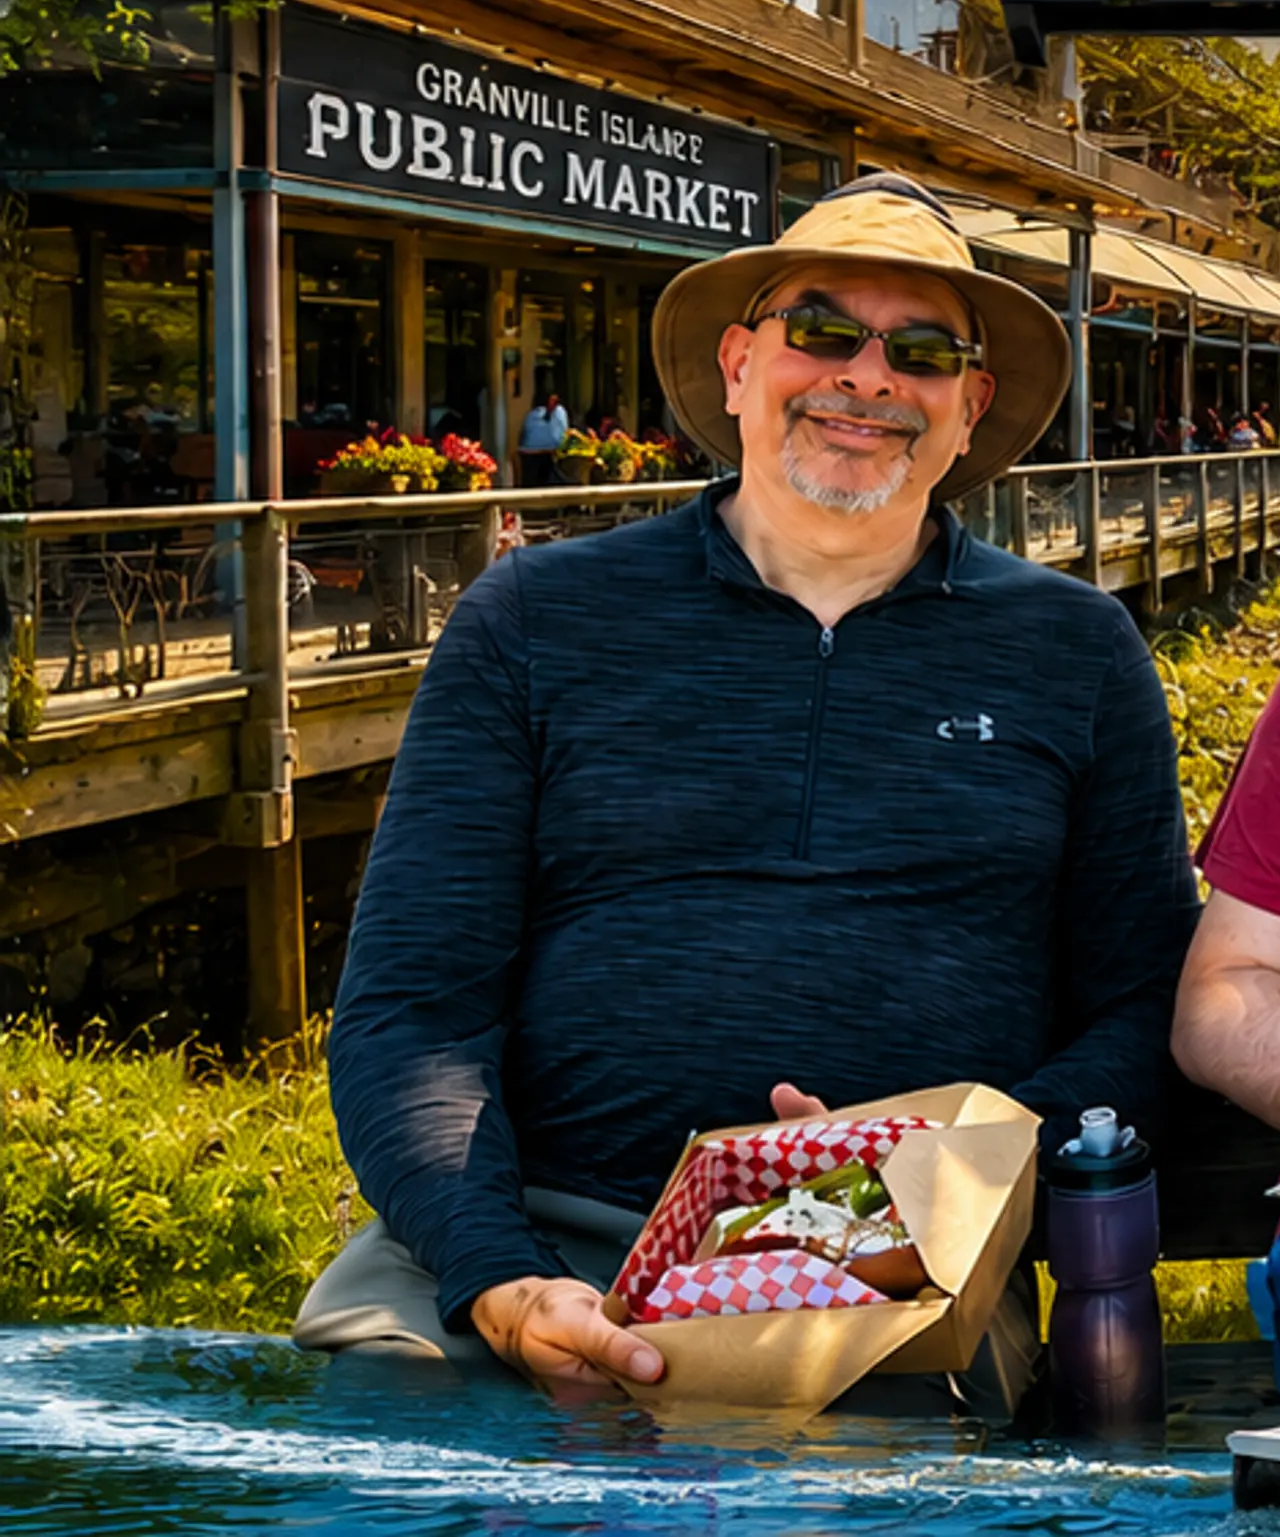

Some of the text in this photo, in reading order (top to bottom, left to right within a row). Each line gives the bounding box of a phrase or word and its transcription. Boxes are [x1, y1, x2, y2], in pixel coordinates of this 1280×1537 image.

[416, 63, 591, 138] GRANVILLE
[305, 91, 760, 238] PUBLIC MARKET
